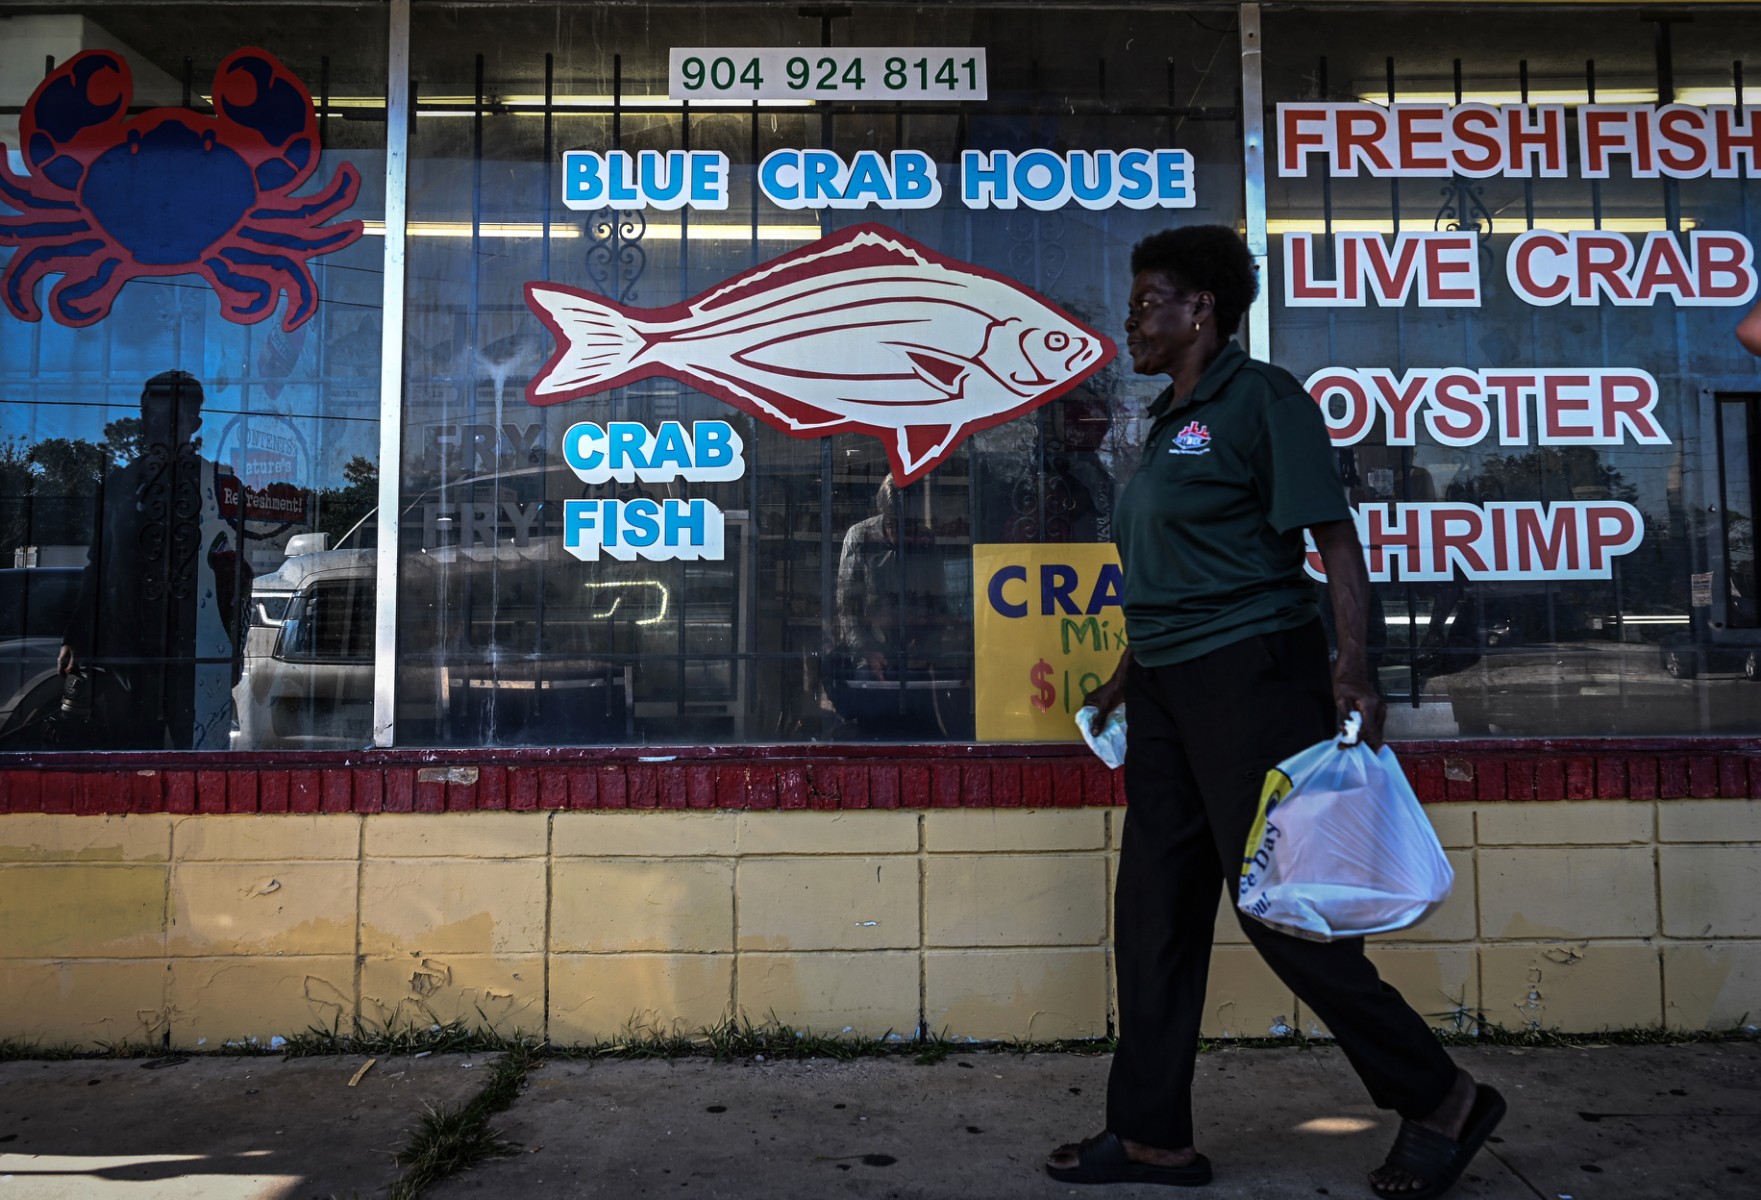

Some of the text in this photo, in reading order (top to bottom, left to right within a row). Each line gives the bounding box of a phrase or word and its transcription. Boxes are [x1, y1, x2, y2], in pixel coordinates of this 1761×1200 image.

[681, 56, 977, 90] 904 924 8141
[1281, 107, 1761, 174] FRESH FISH
[564, 151, 1190, 204] BLUE CRAB HOUSE
[1288, 233, 1754, 303] LIVE CRAB
[1307, 371, 1664, 442] OYSTER
[238, 458, 292, 475] ature's
[561, 421, 739, 475] CRAB
[223, 487, 303, 513] Rereshment!
[564, 499, 714, 553] FISH
[423, 502, 544, 553] FRY
[1304, 505, 1639, 577] HRIMP
[988, 564, 1124, 618] CRA
[1060, 616, 1128, 655] Mix
[1254, 819, 1282, 871] Day
[1249, 891, 1272, 918] ou!
